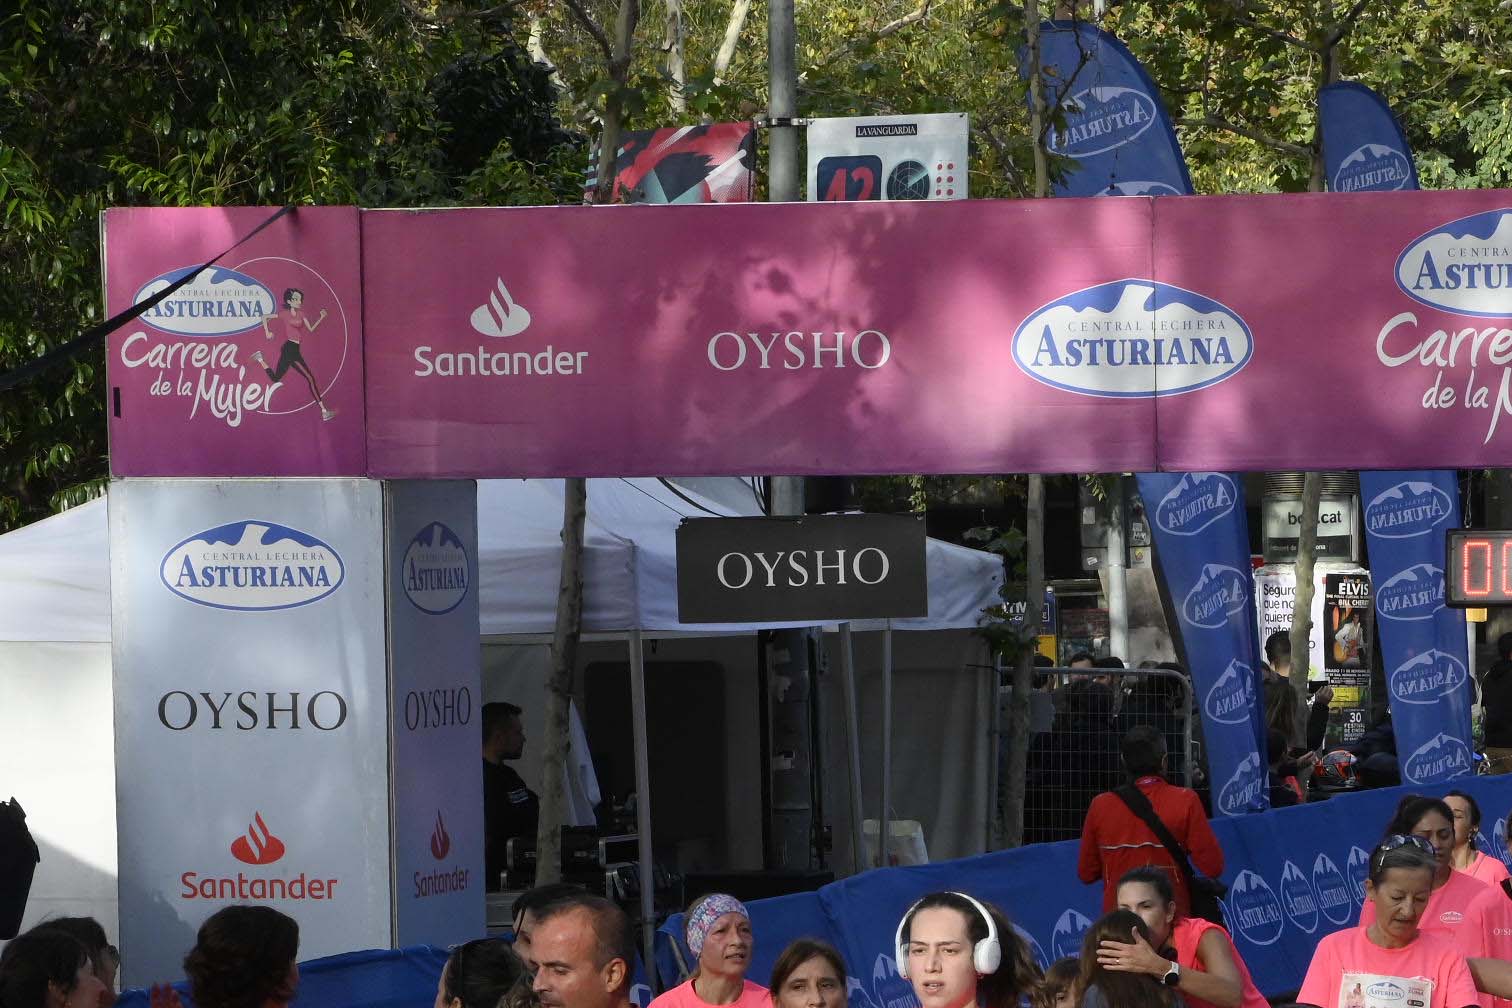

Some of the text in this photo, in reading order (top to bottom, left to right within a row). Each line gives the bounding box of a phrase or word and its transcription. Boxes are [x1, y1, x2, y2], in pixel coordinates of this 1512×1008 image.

[1068, 319, 1225, 332] CENTRAL LECHERA
[120, 331, 241, 369] Carrera
[415, 345, 590, 377] Santander
[707, 330, 891, 370] OYSHO
[1031, 324, 1234, 367] ASTURIANA
[150, 363, 285, 428] de la Mujer
[1422, 370, 1456, 409] de
[1464, 369, 1489, 410] la
[175, 554, 331, 588] ASTURIANA
[202, 551, 326, 562] CENTRAL LECHERA
[717, 546, 891, 590] OYSHO
[407, 557, 465, 593] ASTURIANA
[1338, 582, 1369, 596] ELVIS
[157, 690, 348, 731] OYSHO
[404, 686, 471, 731] OYSHO
[1349, 712, 1362, 723] 30
[179, 871, 338, 900] Santander
[413, 864, 471, 899] Santander
